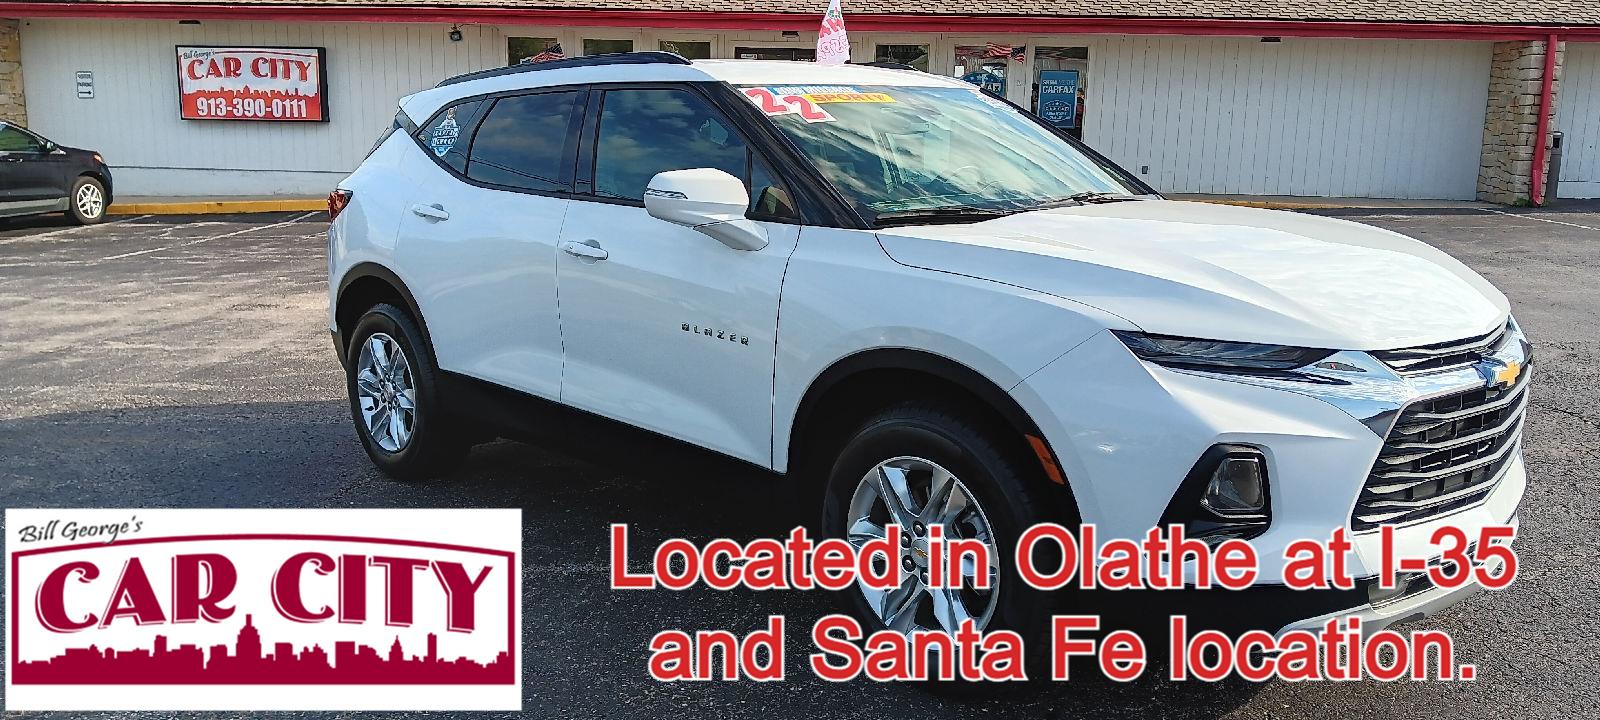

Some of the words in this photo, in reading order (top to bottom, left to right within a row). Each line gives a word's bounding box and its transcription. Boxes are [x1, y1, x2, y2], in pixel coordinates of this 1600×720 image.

[187, 57, 242, 81] CAR
[250, 56, 311, 82] CITY
[1042, 85, 1075, 94] CARFAX
[197, 97, 307, 118] 913-390-0111
[681, 322, 748, 345] BLAZER
